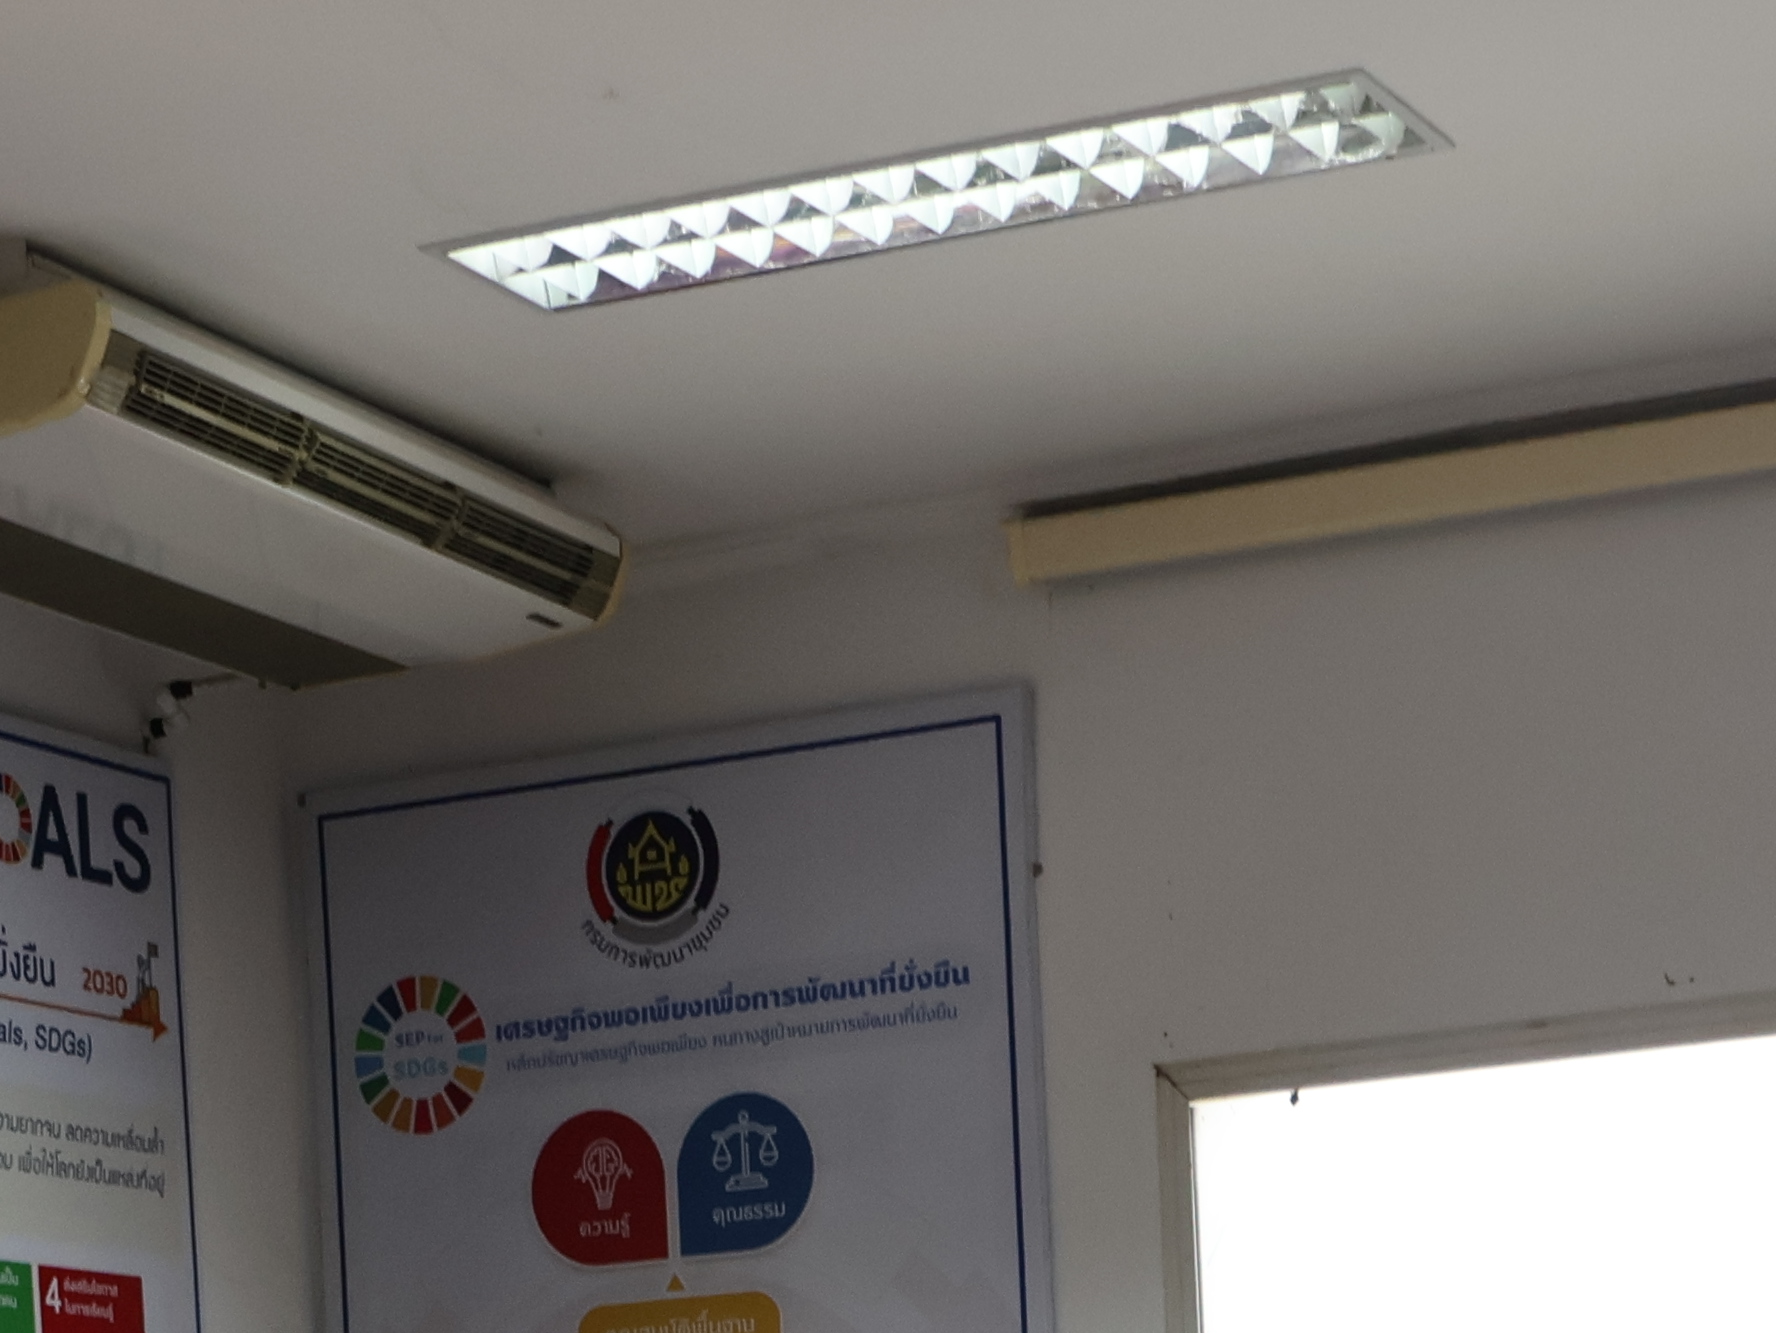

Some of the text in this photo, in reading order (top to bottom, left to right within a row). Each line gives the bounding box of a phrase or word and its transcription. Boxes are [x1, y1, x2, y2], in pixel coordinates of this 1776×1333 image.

[81, 966, 128, 999] 2030
[33, 1020, 94, 1064] SDGs)
[394, 1031, 425, 1048] SEP
[393, 1056, 449, 1081] SDGs
[579, 1215, 632, 1239] ความรู้
[712, 1200, 787, 1227] คุณธรรม
[44, 1275, 63, 1315] 4
